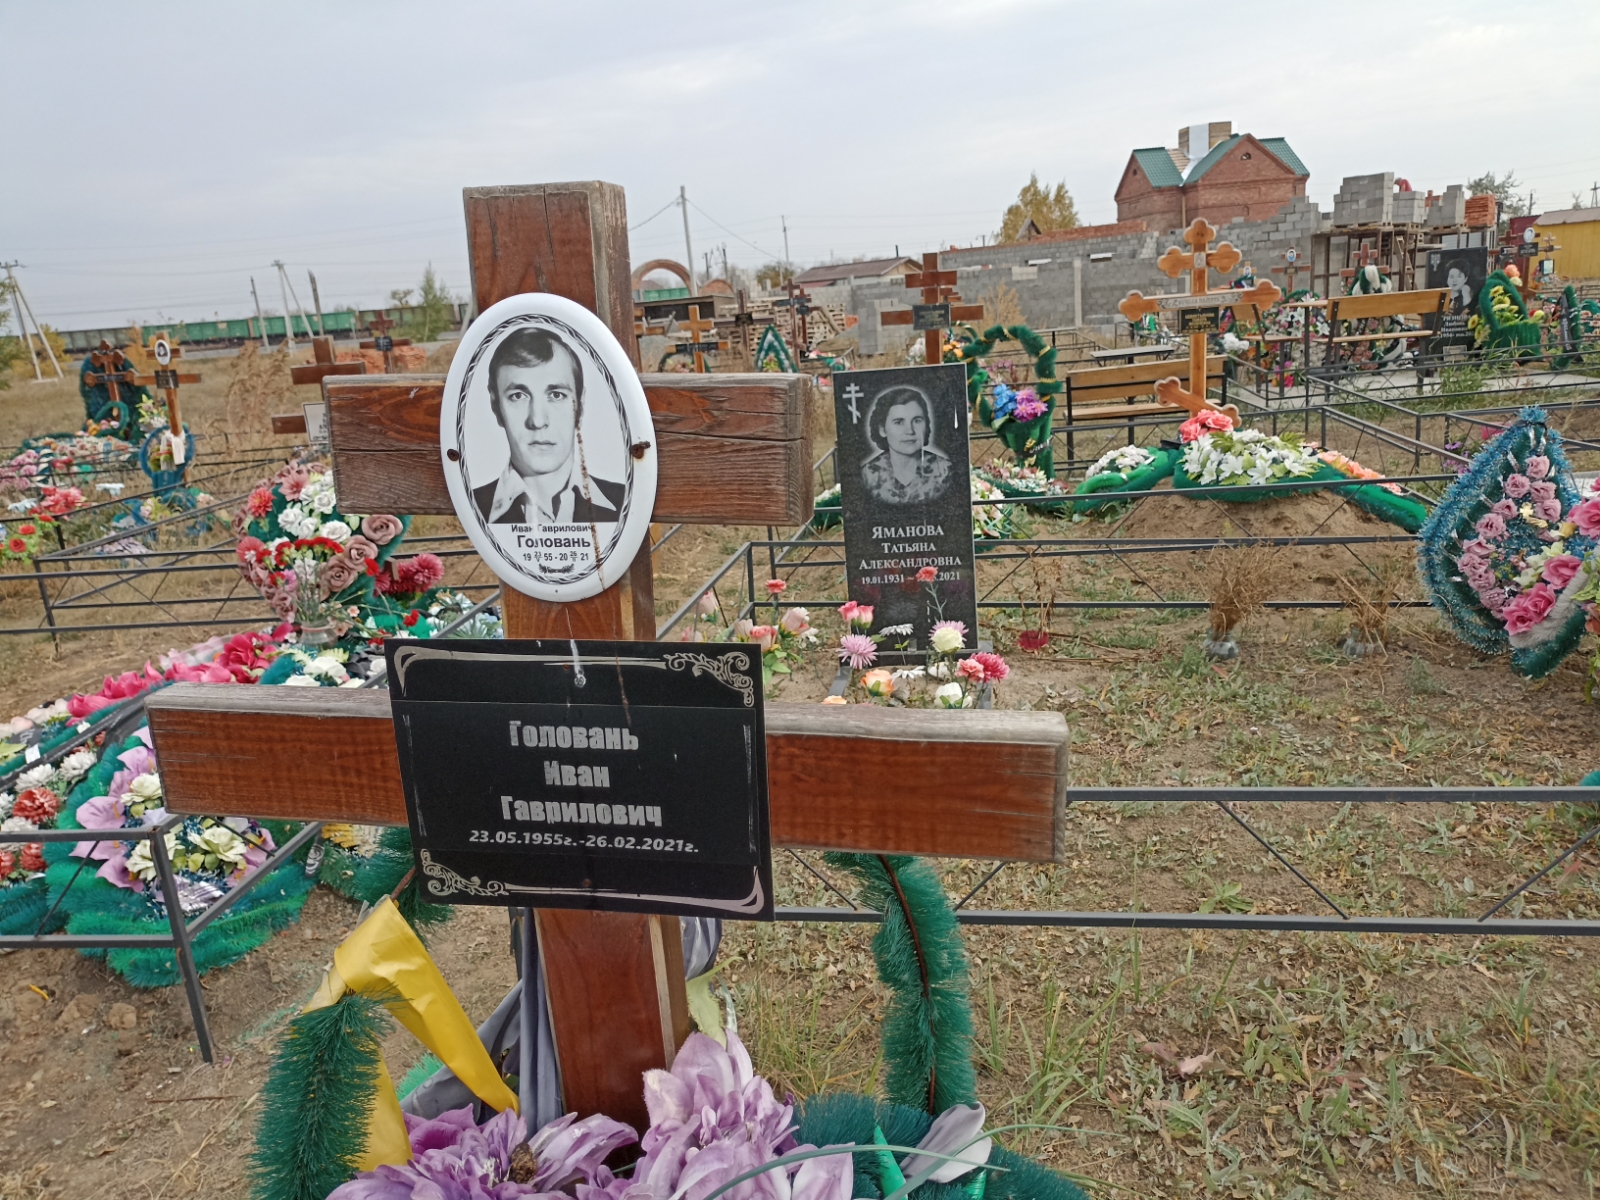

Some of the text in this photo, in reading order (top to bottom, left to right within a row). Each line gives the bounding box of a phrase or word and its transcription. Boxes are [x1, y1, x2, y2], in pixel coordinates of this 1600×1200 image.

[872, 525, 944, 539] ЯМАНОВА
[517, 535, 591, 548] Головань
[881, 542, 936, 554] ТАТЬЯНА
[859, 556, 962, 571] АЛЕКСАНДРОВНА
[509, 720, 639, 751] Головань
[543, 760, 610, 788] Иван
[501, 795, 663, 827] Гаврилович
